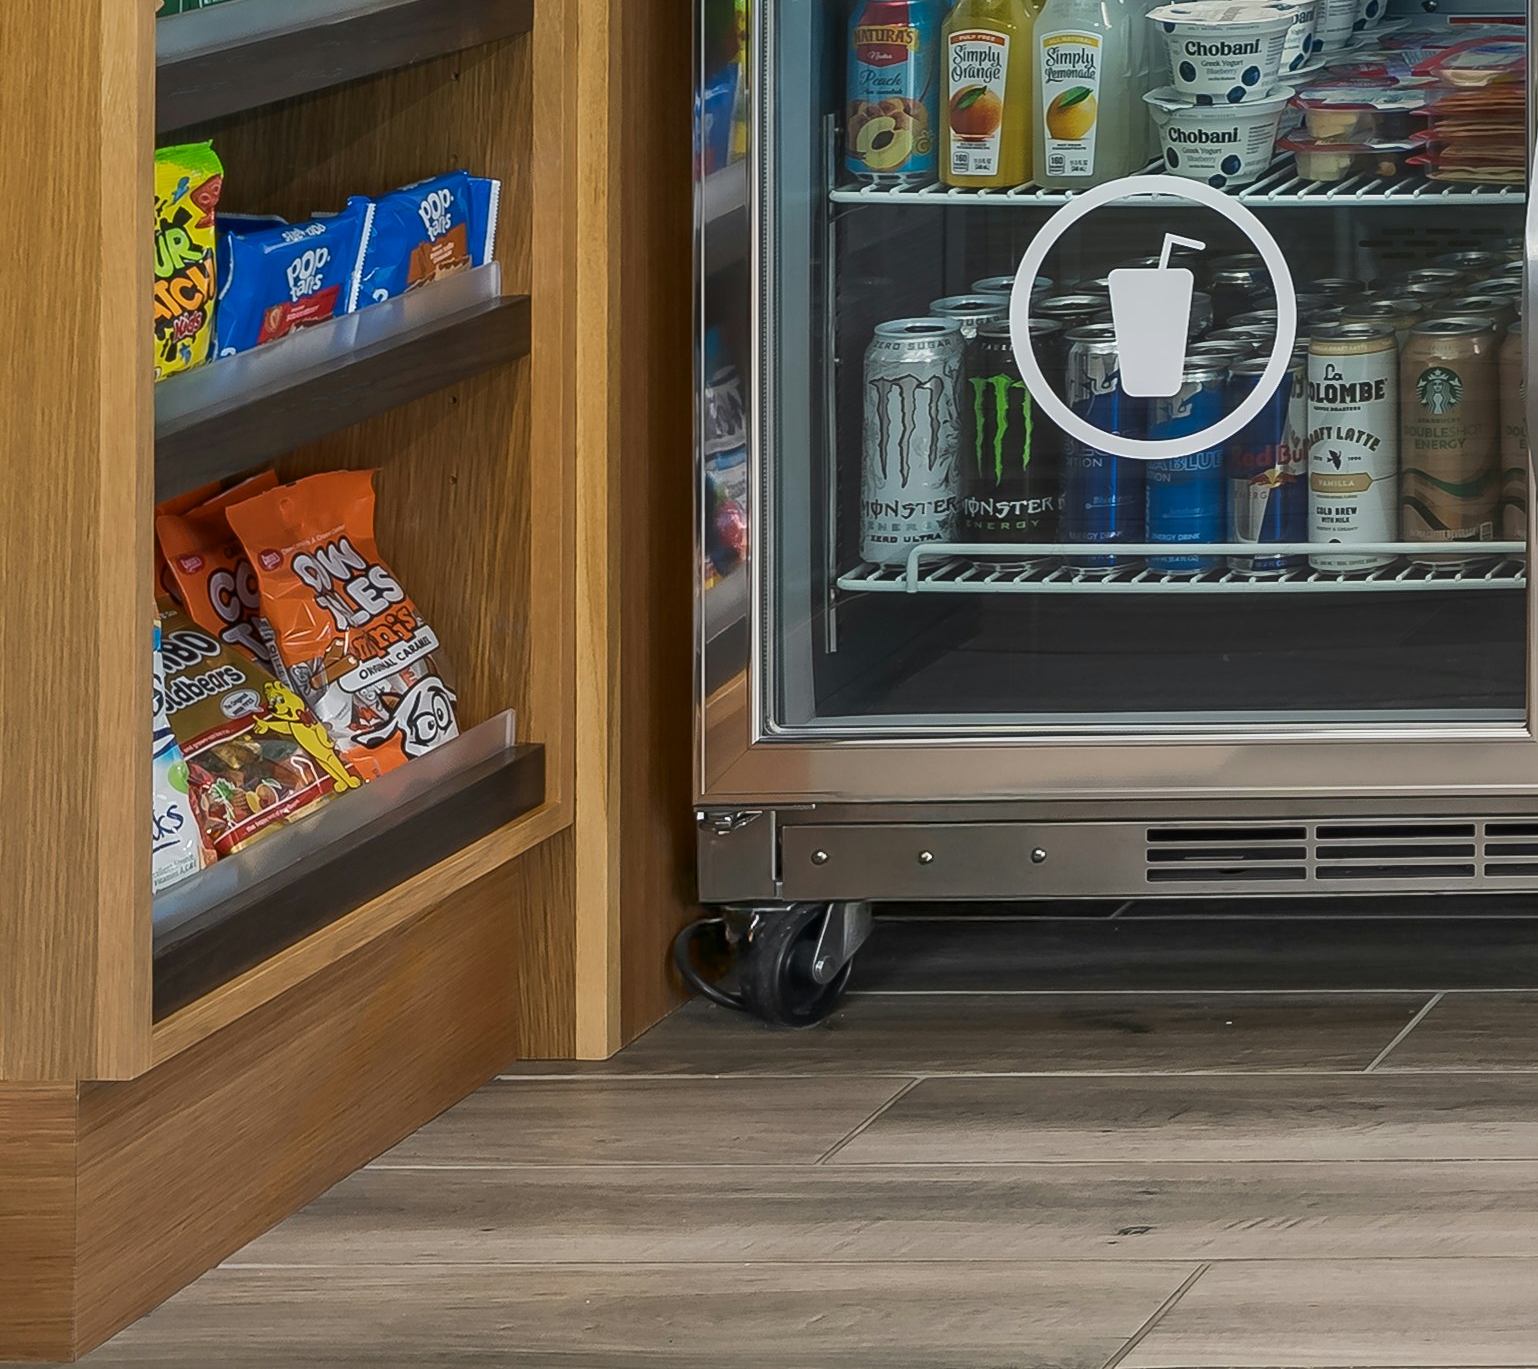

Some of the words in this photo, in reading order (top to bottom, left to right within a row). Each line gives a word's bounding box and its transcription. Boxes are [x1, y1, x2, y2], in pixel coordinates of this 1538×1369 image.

[949, 42, 1003, 69] Simply
[949, 60, 1002, 84] Orange
[1318, 479, 1355, 488] VANILLA
